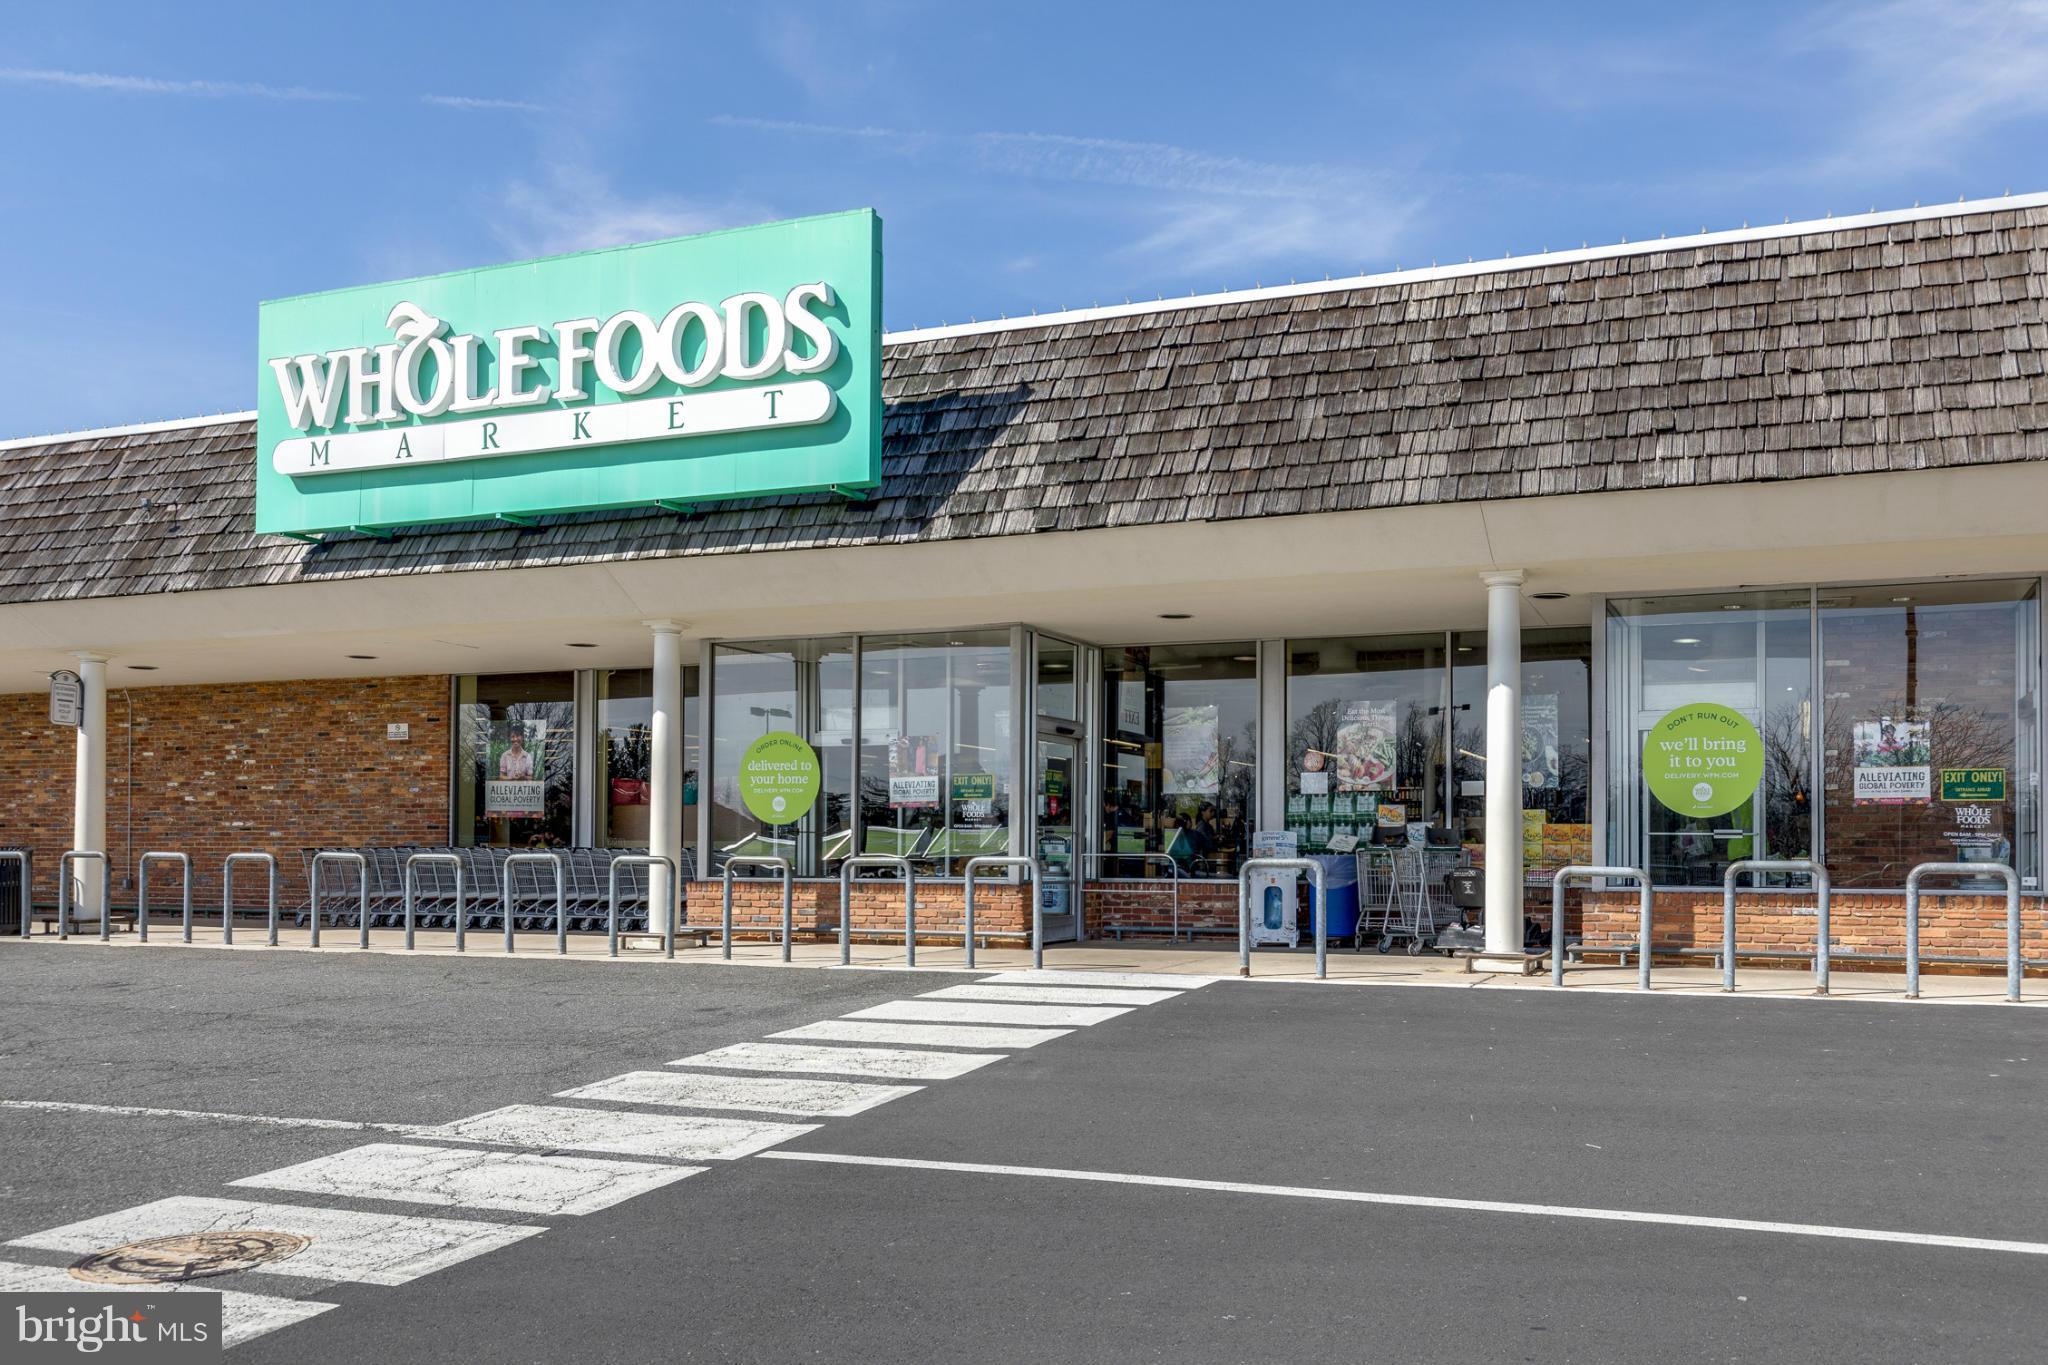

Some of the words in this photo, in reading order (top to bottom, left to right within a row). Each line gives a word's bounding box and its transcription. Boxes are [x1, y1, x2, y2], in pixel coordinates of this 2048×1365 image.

[267, 301, 552, 431] WHOLE
[553, 281, 839, 402] FOODS
[308, 389, 785, 467] MARKET
[1667, 713, 1694, 731] DON'T
[1697, 712, 1718, 720] RUN
[1719, 715, 1739, 729] OUT
[756, 739, 778, 754] ORDER
[779, 739, 803, 753] ONLINE
[1660, 738, 1698, 751] we'll
[1703, 737, 1746, 753] bring
[747, 759, 798, 771] delivered
[800, 761, 812, 771] to
[1670, 755, 1681, 768] it
[1686, 755, 1702, 768] to
[1706, 756, 1736, 769] you
[750, 775, 775, 787] your
[777, 773, 809, 784] home
[953, 776, 969, 785] EXIT
[971, 776, 992, 785] ONLY!
[1860, 771, 1926, 782] ALLEVIATING
[1944, 772, 1966, 783] EXIT
[1971, 771, 2003, 783] ONLY!
[490, 785, 541, 796] ALLEVIATING
[892, 781, 936, 789] ALLEVIATING
[1859, 782, 1886, 790] GLOBAL
[1889, 781, 1926, 789] POVERTY
[490, 795, 511, 804] GLOBAL
[513, 795, 541, 803] POVERTY
[961, 801, 986, 812] WHOLE
[1955, 804, 1992, 816] WHOLE
[1956, 816, 1991, 824] FOODS
